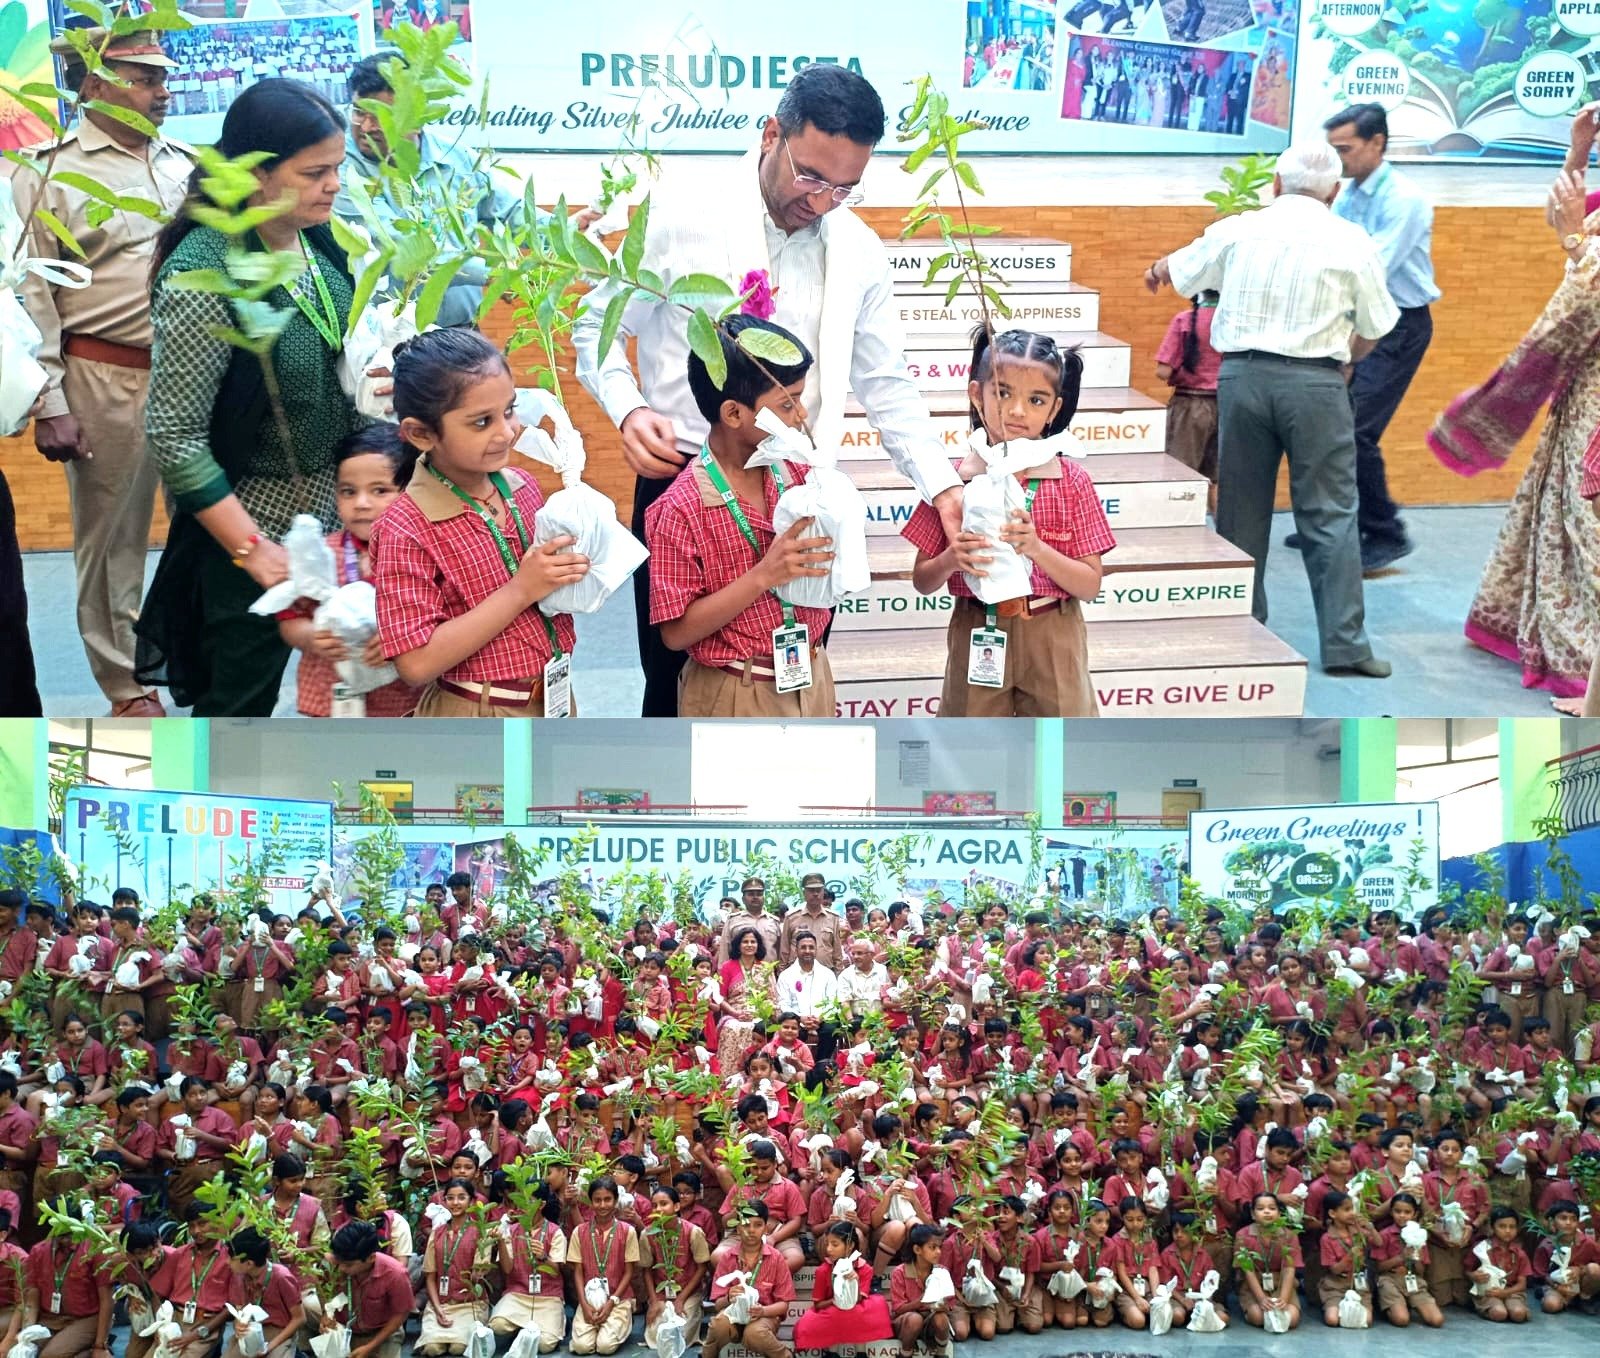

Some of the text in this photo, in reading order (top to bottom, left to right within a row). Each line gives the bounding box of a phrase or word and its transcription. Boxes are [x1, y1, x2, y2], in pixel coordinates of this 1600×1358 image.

[1321, 3, 1381, 16] AFTERNOON
[1356, 66, 1399, 79] GREEN
[1526, 71, 1575, 83] GREEN
[1348, 82, 1405, 95] EVENING
[1522, 86, 1575, 98] SORRY
[561, 101, 643, 130] Silver
[650, 103, 750, 134] Jubilee
[888, 256, 921, 270] HAN
[912, 309, 957, 322] STEAL
[1076, 422, 1150, 441] CIENCY
[876, 596, 908, 613] TO
[1113, 587, 1160, 604] YOU
[1167, 584, 1247, 601] EXPIRE
[1097, 687, 1153, 706] VER
[1163, 684, 1229, 704] GIVE
[1237, 682, 1275, 701] UP
[77, 799, 257, 839] PRELUDE
[1205, 818, 1282, 844] Green
[1286, 815, 1407, 843] Greetings
[538, 836, 665, 864] PRELUDE
[676, 837, 778, 864] PUBLIC
[935, 838, 1024, 865] AGRA
[1362, 877, 1395, 887] GREEN
[1362, 887, 1395, 897] THANK
[1368, 898, 1389, 908] YOU
